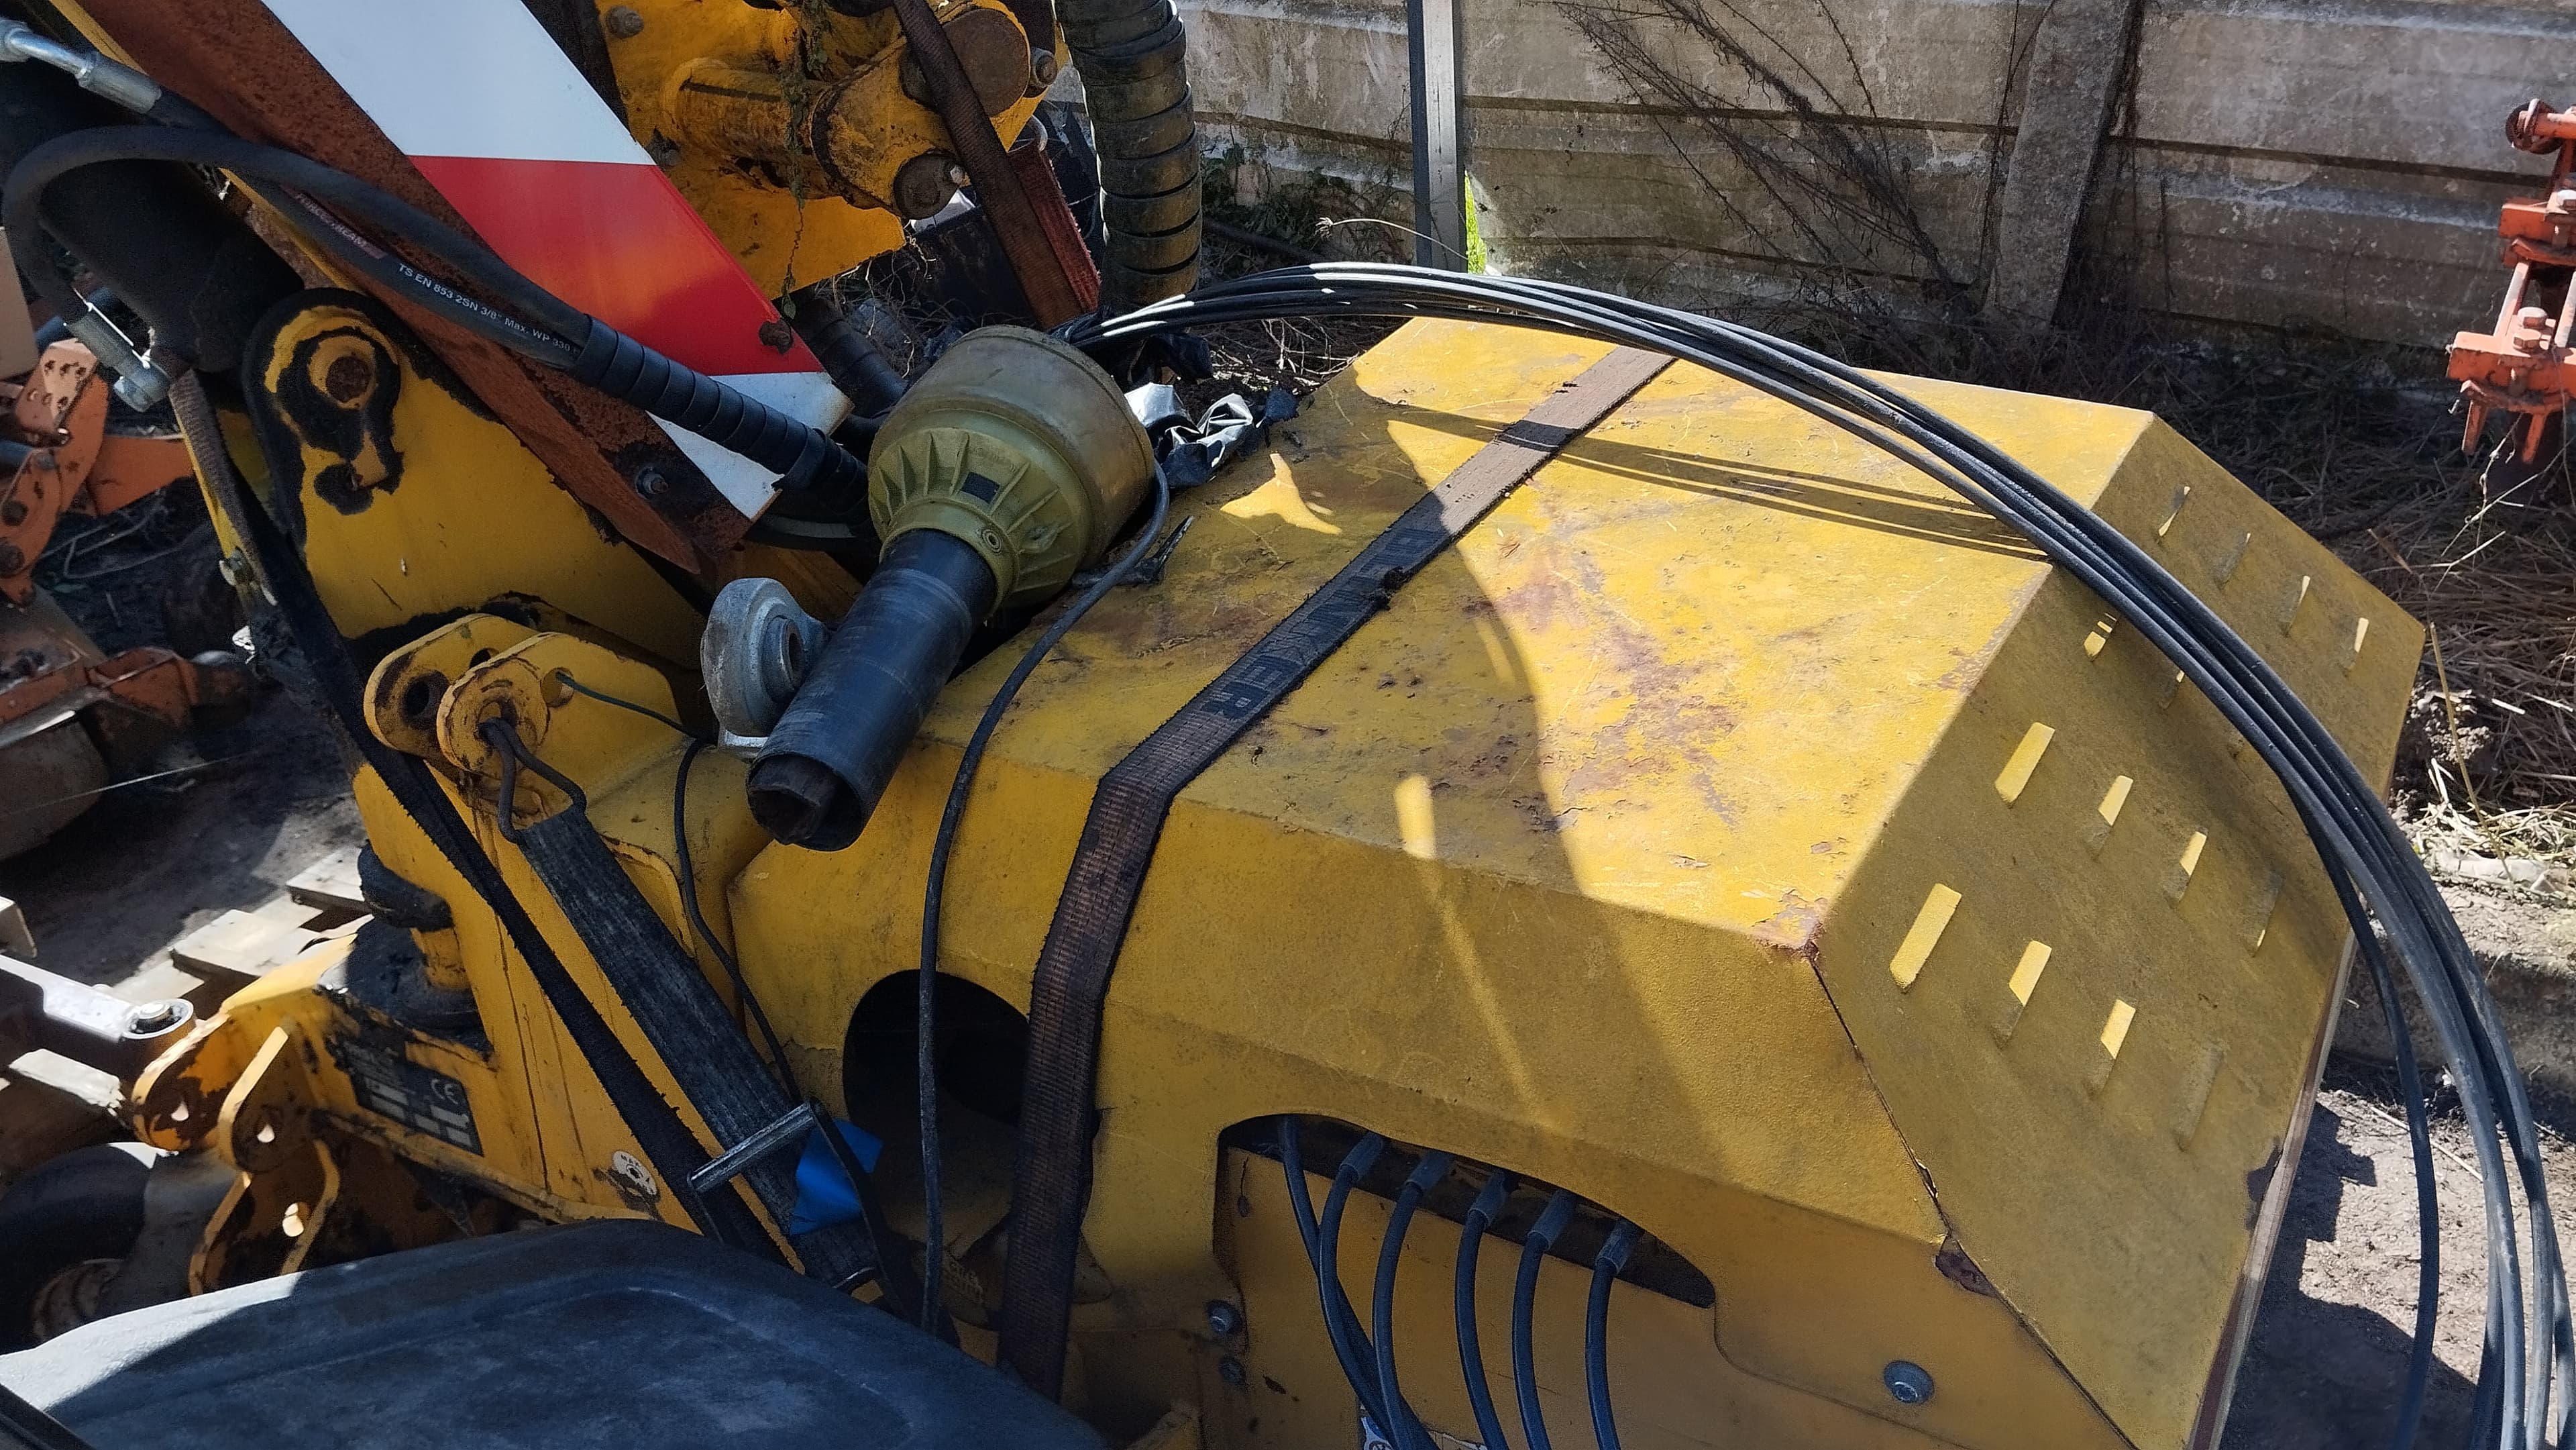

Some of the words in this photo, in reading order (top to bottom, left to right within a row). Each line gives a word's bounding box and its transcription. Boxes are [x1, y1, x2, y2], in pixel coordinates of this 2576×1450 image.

[398, 263, 413, 276] TS
[415, 273, 432, 288] EN
[433, 284, 453, 299] 853
[455, 295, 478, 311] 2SN
[504, 317, 529, 334] Max.
[533, 329, 550, 342] WP
[552, 338, 571, 352] 330
